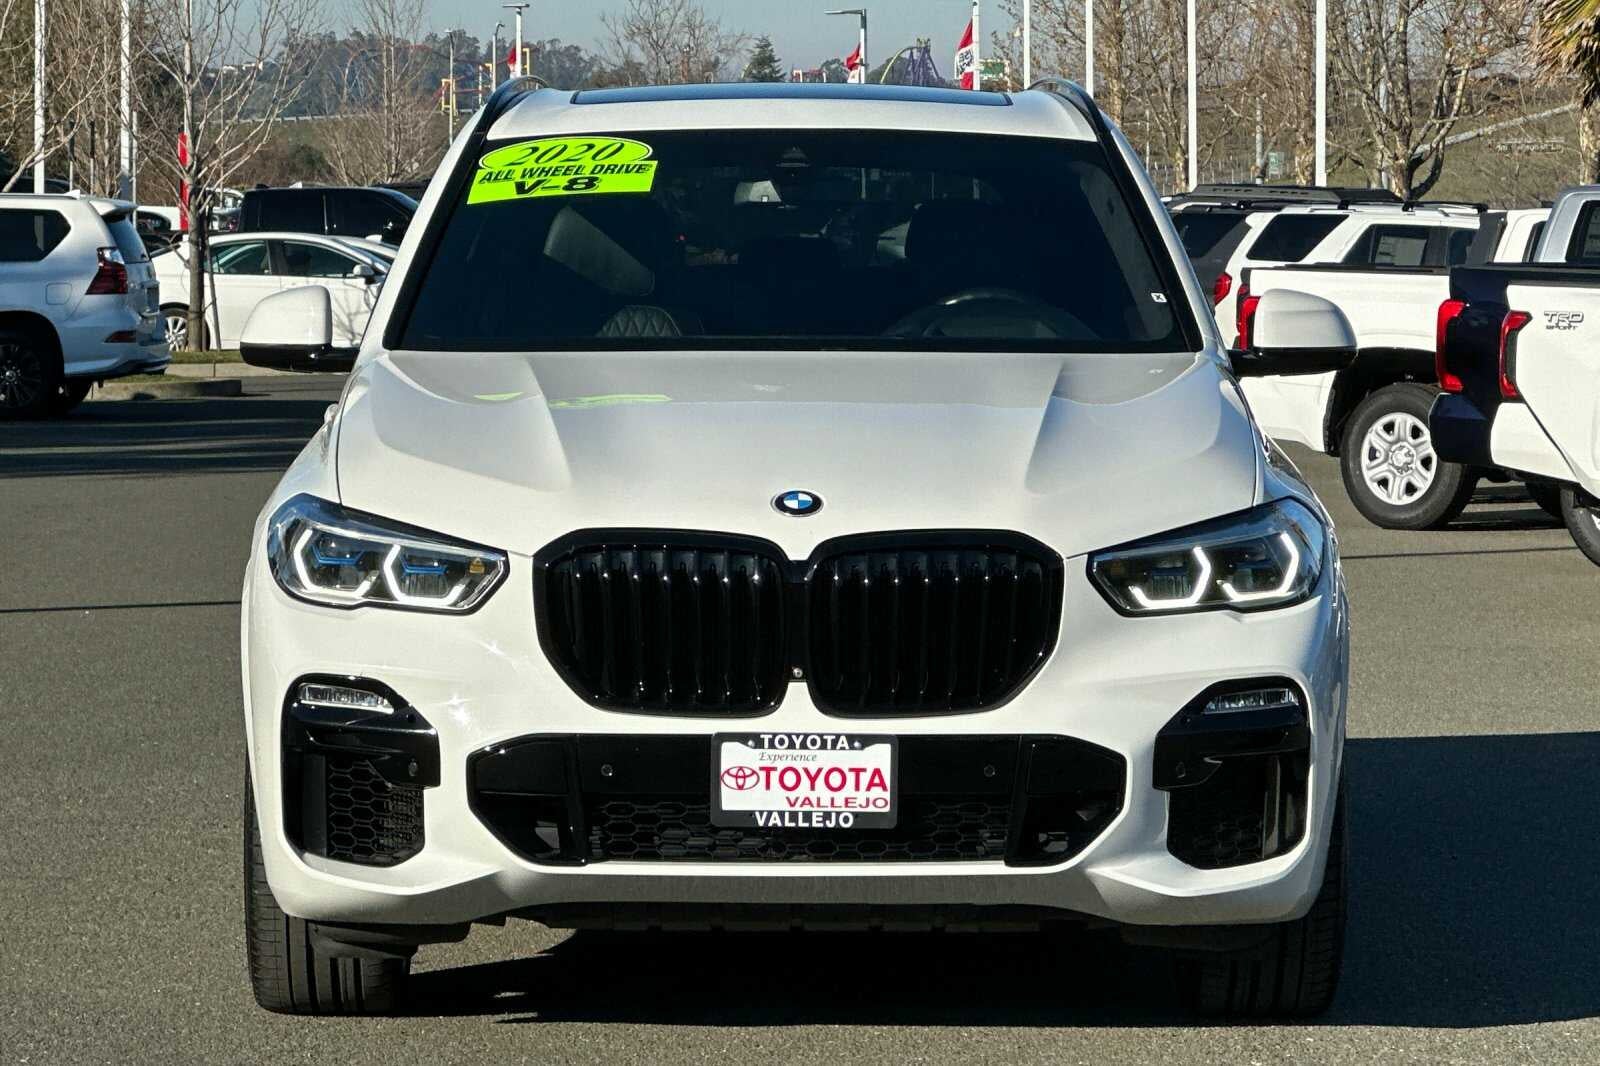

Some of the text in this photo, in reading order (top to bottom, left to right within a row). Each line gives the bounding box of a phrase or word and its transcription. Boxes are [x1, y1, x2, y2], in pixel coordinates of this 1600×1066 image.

[504, 142, 625, 167] 2020
[478, 162, 653, 185] ALL WHEEL DRIVE
[514, 175, 601, 196] V-8
[1543, 310, 1585, 323] TRD
[760, 734, 850, 750] TOYOTA
[758, 751, 818, 764] Experience
[758, 766, 889, 792] TOYOTA
[785, 796, 889, 809] VALLEJO
[755, 811, 855, 828] VALLEJO
